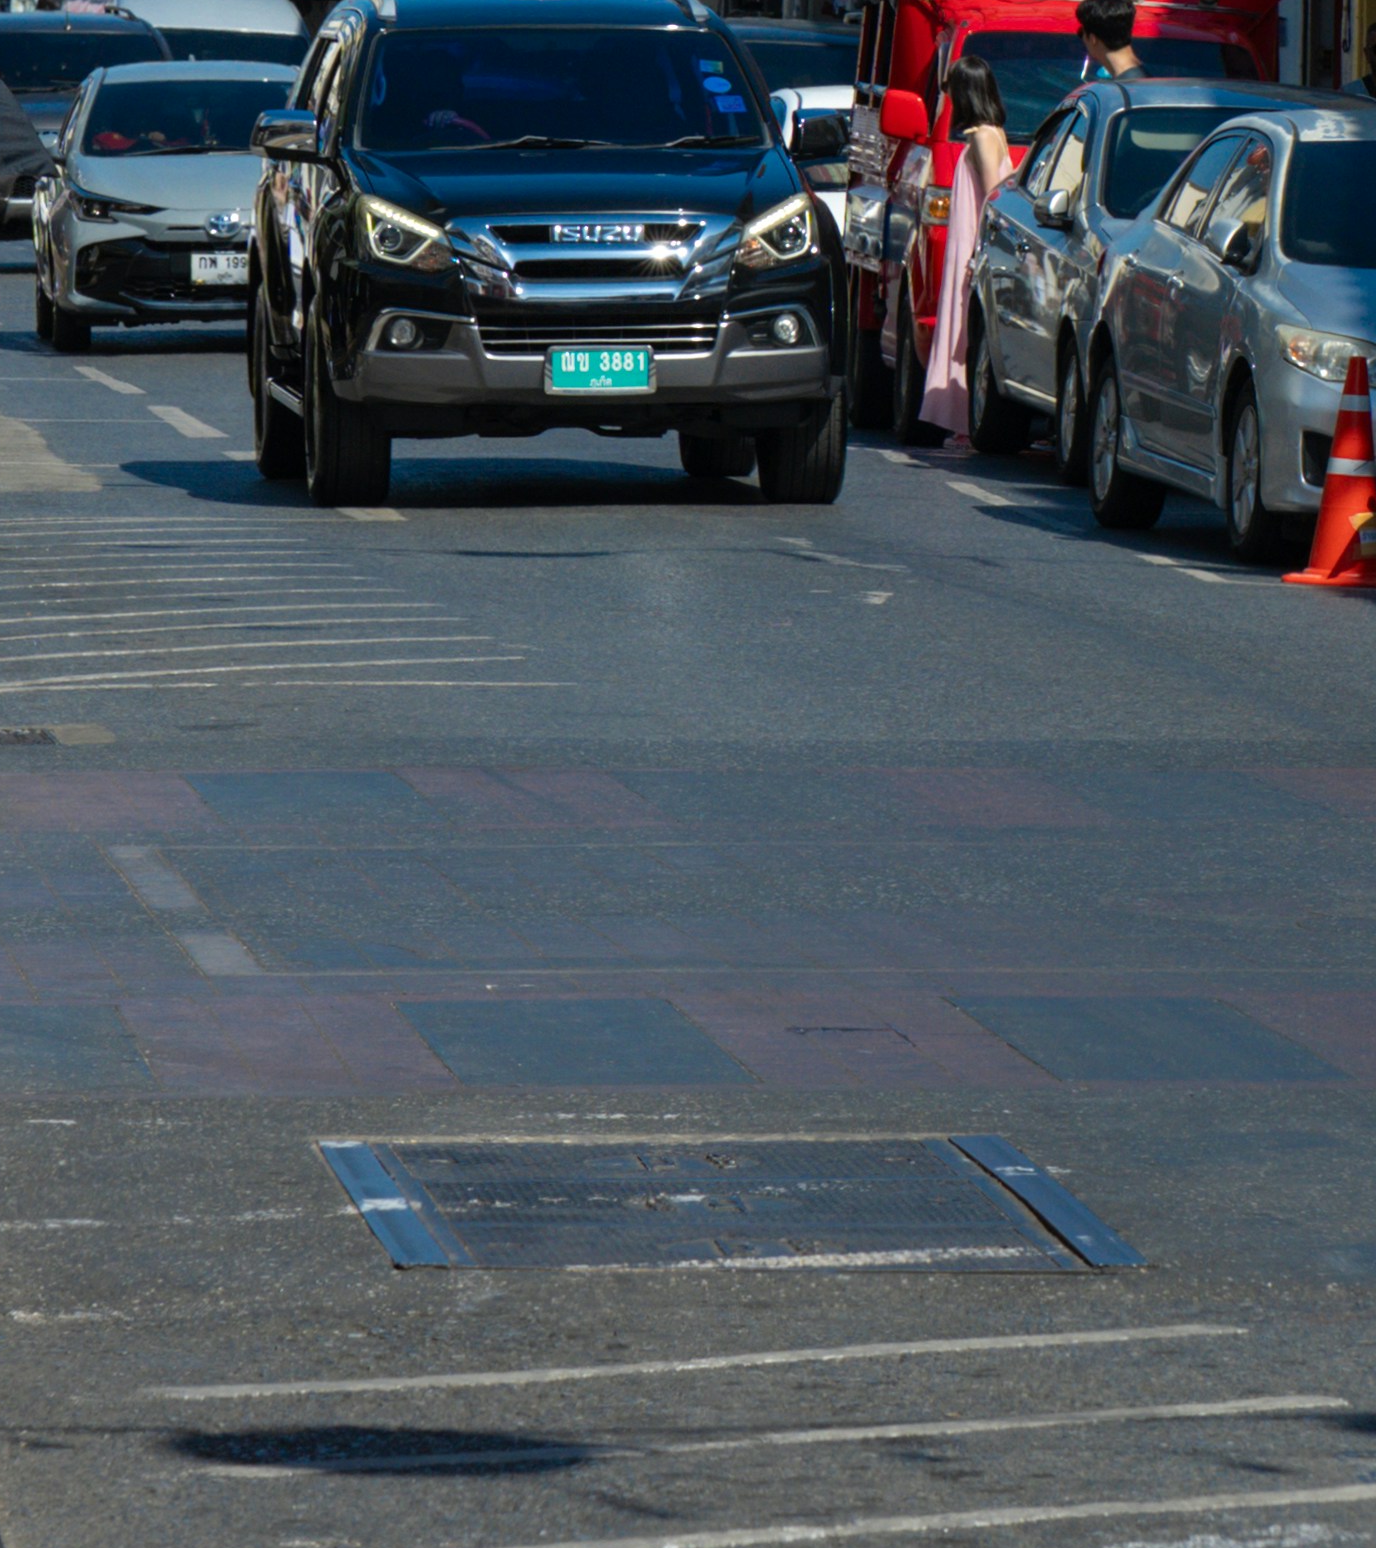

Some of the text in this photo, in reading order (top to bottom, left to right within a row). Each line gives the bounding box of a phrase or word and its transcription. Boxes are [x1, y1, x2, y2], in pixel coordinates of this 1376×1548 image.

[554, 225, 643, 242] ISUZU
[226, 256, 247, 269] 199
[599, 352, 645, 372] 3881
